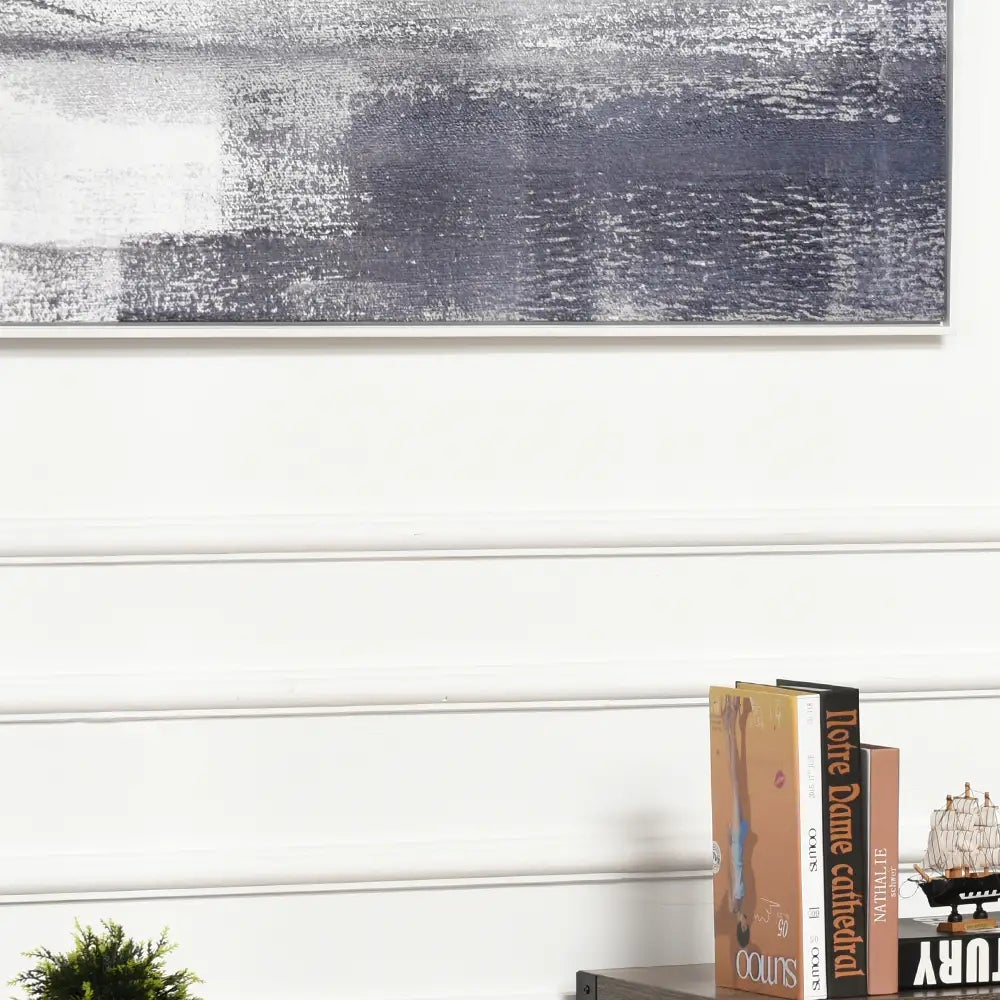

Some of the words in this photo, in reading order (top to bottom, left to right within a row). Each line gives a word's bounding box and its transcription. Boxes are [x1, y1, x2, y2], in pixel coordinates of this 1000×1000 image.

[825, 709, 857, 777] Notre
[828, 784, 861, 855] Dame
[831, 863, 865, 979] cathedral
[874, 847, 888, 923] NATHALIE
